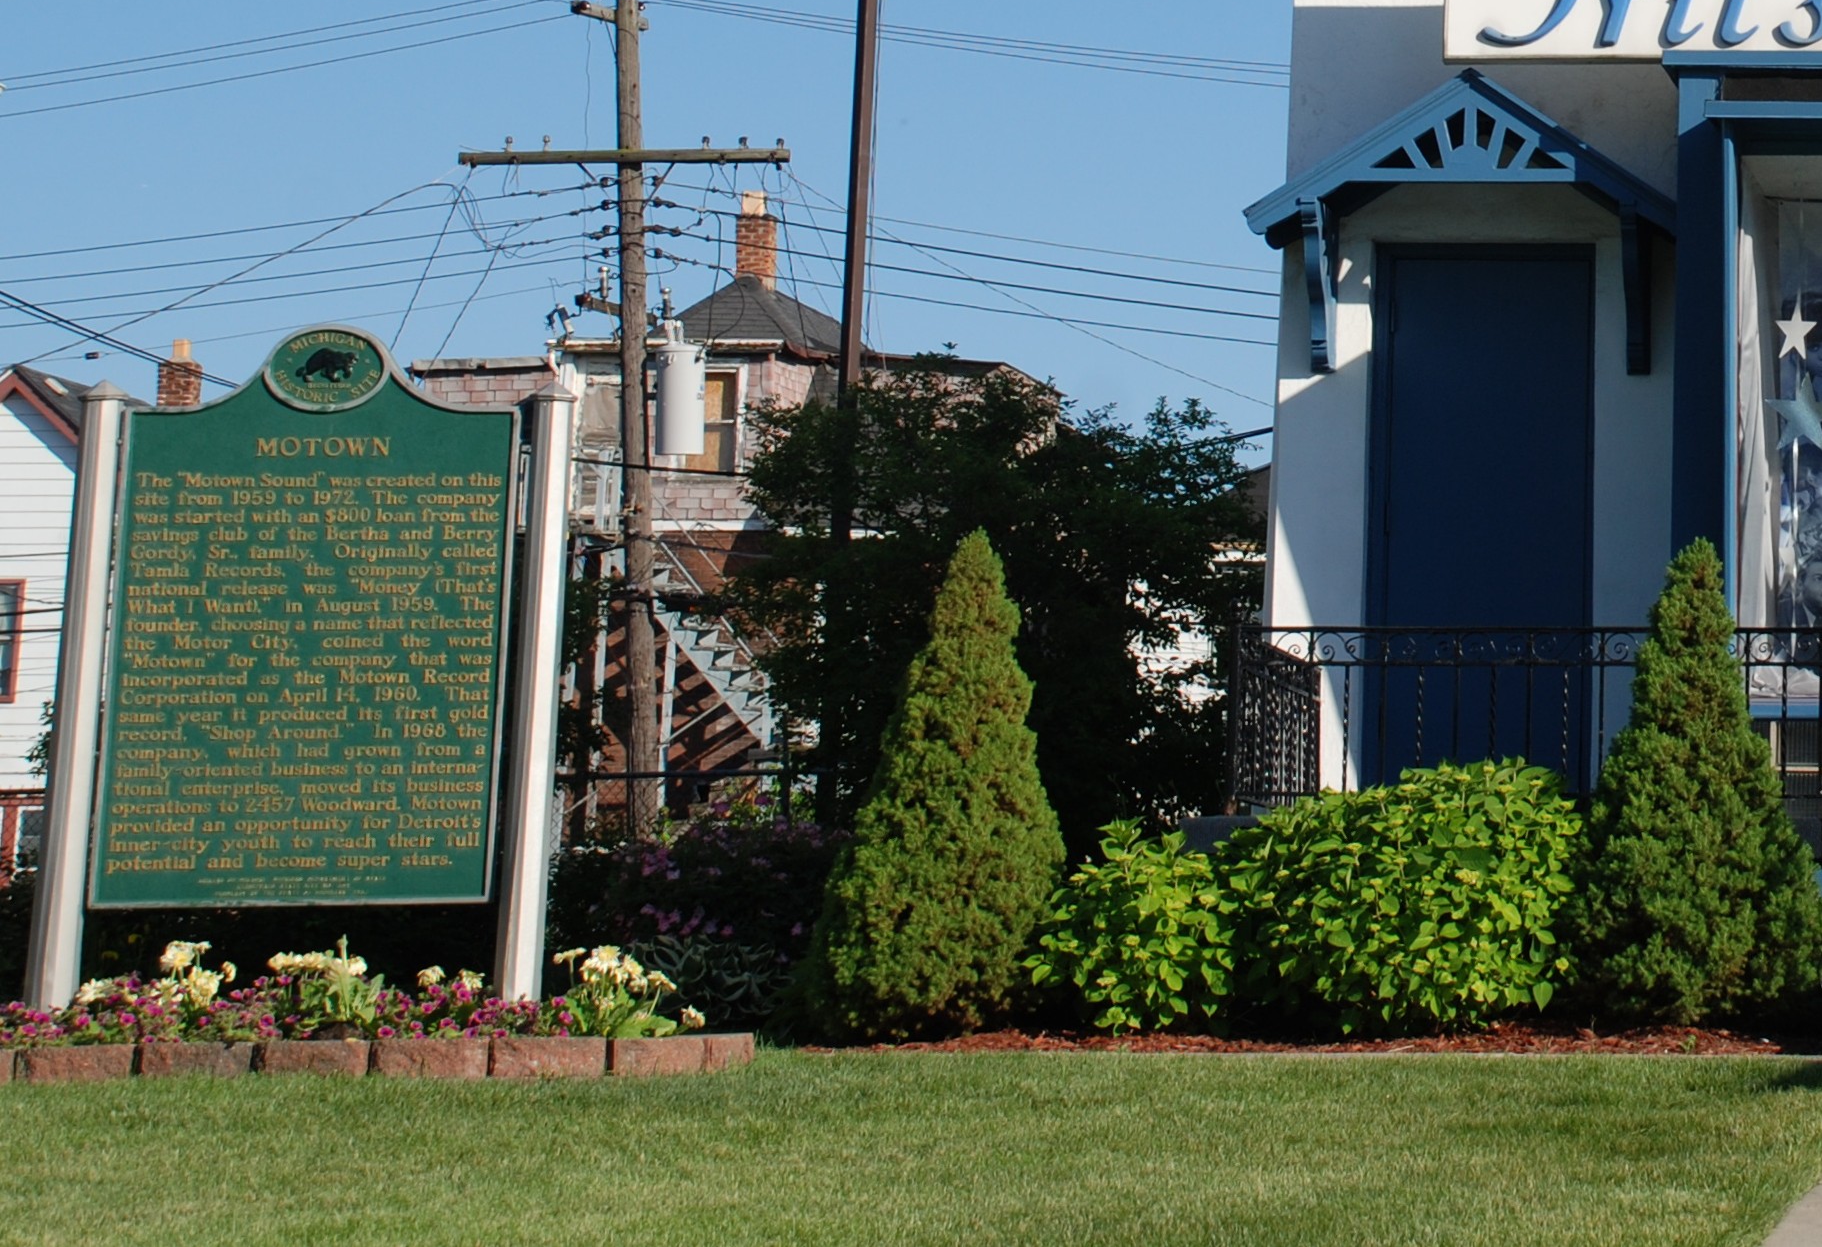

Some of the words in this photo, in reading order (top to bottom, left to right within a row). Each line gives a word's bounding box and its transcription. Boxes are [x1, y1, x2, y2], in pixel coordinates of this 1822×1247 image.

[290, 333, 367, 353] MICHIGAN
[275, 369, 338, 402] HISTORIC
[350, 369, 380, 398] SITE
[256, 437, 391, 457] MOTOWN
[135, 473, 172, 488] The
[328, 476, 362, 487] was
[364, 472, 436, 487] created
[440, 476, 464, 486] on
[466, 472, 502, 486] this
[133, 491, 169, 506] site
[176, 491, 222, 506] from
[230, 491, 276, 505] 1959
[283, 491, 304, 505] to
[312, 490, 358, 505] 1972.
[370, 490, 406, 505] The
[416, 494, 500, 508] company
[132, 513, 168, 524] was
[172, 509, 244, 524] started
[250, 509, 292, 523] with
[296, 512, 320, 523] an
[324, 508, 370, 524] $800
[374, 508, 416, 522] loan
[420, 508, 466, 522] from
[468, 508, 499, 522] the
[130, 527, 199, 546] savings
[207, 527, 248, 542] club
[258, 527, 277, 541] of
[286, 527, 317, 541] the
[324, 526, 390, 541] Bertha
[398, 526, 433, 540] and
[441, 526, 498, 544] Berry
[247, 545, 314, 563] family.
[333, 544, 432, 562] Originally
[440, 543, 498, 558] called
[129, 564, 189, 578] Tamla
[303, 562, 335, 577] the
[347, 562, 444, 580] company's
[454, 561, 497, 576] first
[126, 582, 206, 597] national
[219, 581, 287, 596] release
[301, 584, 336, 595] was
[434, 579, 496, 594] (That's
[125, 600, 175, 615] What
[283, 599, 303, 613] in
[315, 598, 380, 616] August
[391, 597, 437, 612] 1959.
[458, 597, 494, 611] The
[210, 617, 289, 636] choosing
[293, 621, 306, 631] a
[311, 620, 361, 631] name
[365, 616, 405, 630] that
[408, 615, 494, 630] reflected
[122, 636, 156, 651] the
[172, 636, 232, 651] Motor
[320, 634, 384, 649] coined
[399, 633, 430, 648] the
[446, 633, 493, 647] word
[226, 654, 257, 668] for
[268, 653, 300, 668] the
[309, 656, 396, 671] company
[407, 651, 447, 666] that
[457, 654, 492, 665] was
[119, 672, 247, 692] incorporated
[259, 675, 279, 686] as
[292, 671, 325, 686] the
[337, 670, 410, 685] Motown
[422, 668, 491, 684] Record
[117, 690, 236, 710] Corporation
[244, 694, 268, 704] on
[277, 689, 327, 708] April
[373, 687, 420, 702] 1960.
[443, 686, 490, 701] That
[117, 713, 164, 725] same
[175, 712, 221, 727] year
[230, 708, 246, 723] it
[256, 707, 347, 726] produced
[356, 706, 382, 721] its
[392, 705, 437, 720] first
[448, 704, 489, 723] gold
[373, 724, 392, 738] In
[451, 722, 487, 737] the
[225, 744, 281, 759] which
[296, 743, 329, 758] had
[342, 746, 401, 761] grown
[415, 741, 460, 756] from
[472, 744, 486, 755] a
[113, 763, 262, 784] family-oriented
[270, 761, 348, 777] business
[354, 760, 375, 775] to
[380, 764, 404, 775] an
[111, 783, 169, 798] tional
[298, 779, 362, 794] moved
[371, 778, 396, 793] its
[405, 776, 484, 792] business
[109, 800, 210, 820] operations
[217, 800, 238, 814] to
[244, 798, 293, 814] 2457
[300, 796, 400, 813] Woodward.
[409, 795, 482, 810] Motown
[107, 819, 194, 839] provided
[201, 822, 225, 833] an
[233, 816, 350, 836] opportunity
[360, 815, 390, 830] for
[397, 813, 482, 829] Detroit's
[107, 837, 209, 858] inner-city
[221, 835, 280, 855] youth
[290, 835, 312, 850] to
[322, 833, 376, 849] reach
[386, 832, 434, 847] their
[445, 831, 480, 846] full
[104, 856, 195, 876] potential
[205, 854, 243, 870] and
[254, 852, 326, 869] become
[336, 855, 389, 870] super
[400, 850, 452, 865] stars.
